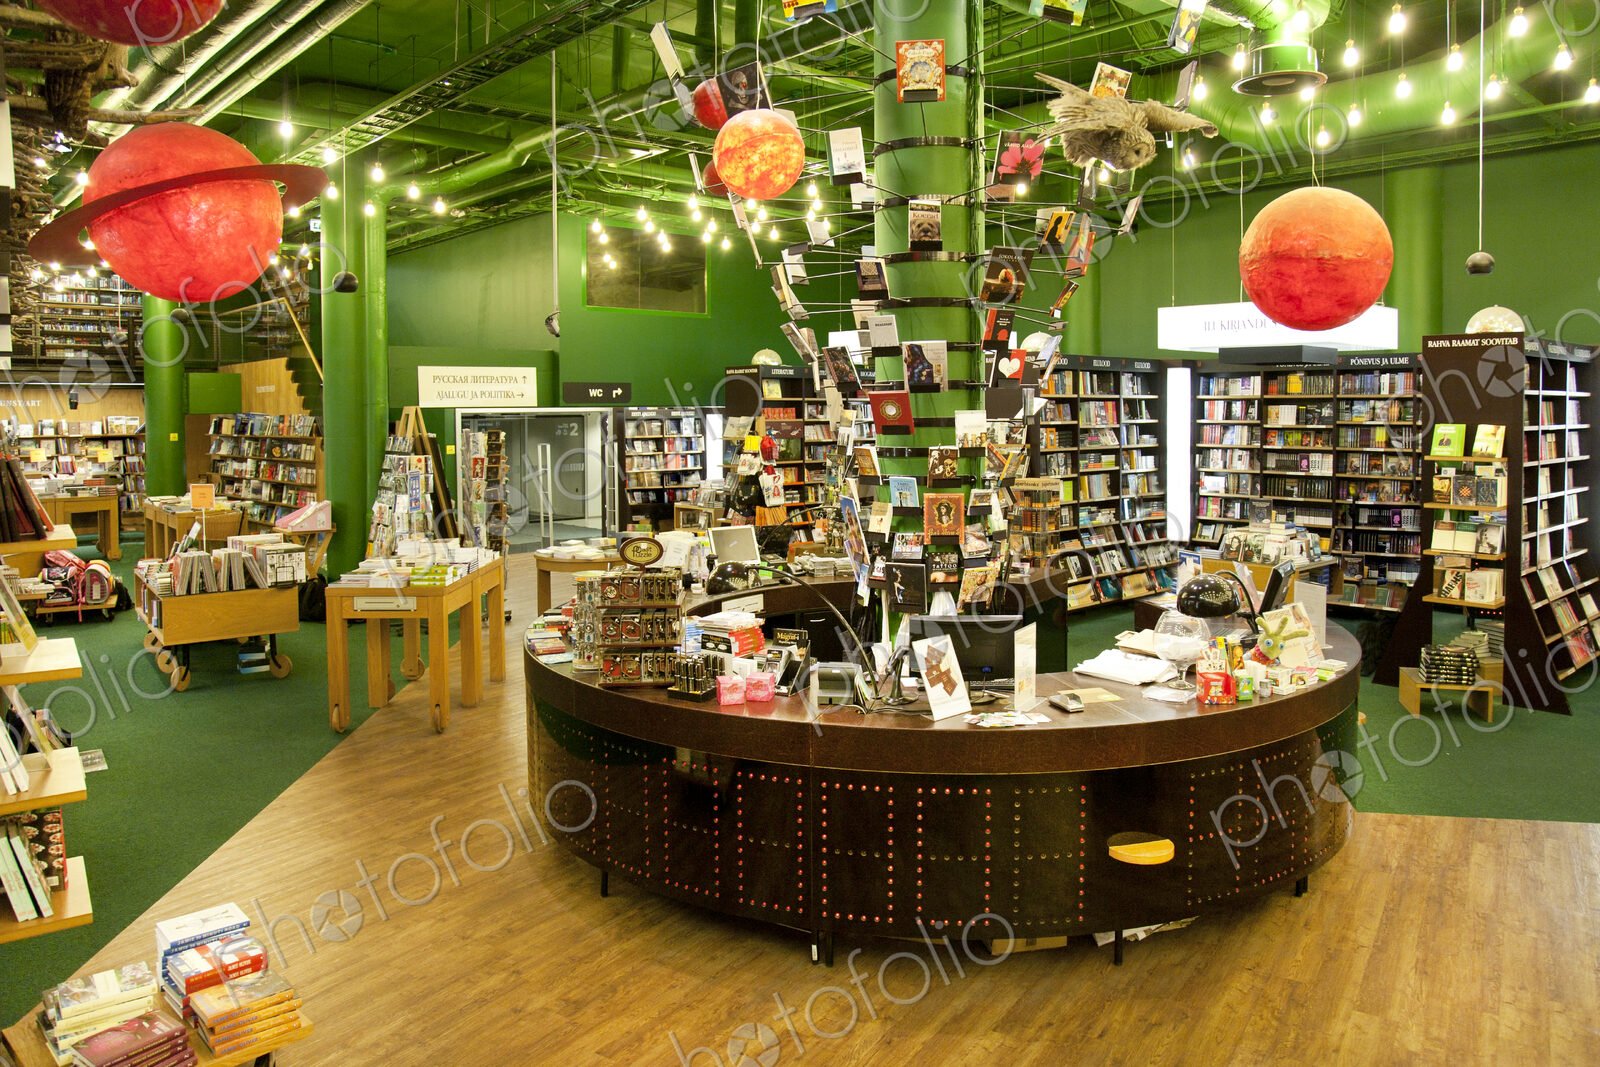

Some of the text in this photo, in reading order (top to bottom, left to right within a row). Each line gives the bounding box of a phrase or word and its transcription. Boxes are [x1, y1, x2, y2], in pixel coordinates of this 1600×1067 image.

[1427, 340, 1450, 348] RAHVA
[1451, 338, 1480, 347] RAAMAT
[1481, 337, 1518, 346] SOOVITAB
[1350, 356, 1409, 367] PÕNEVUS JA ULME
[432, 375, 518, 384] РУССКАЯ ЛИТЕРАТУРА
[436, 390, 515, 400] AJALUGU JA POLIITIKA
[588, 388, 603, 397] WC
[569, 422, 579, 436] 2
[1441, 571, 1463, 598] HARMS
[231, 1007, 251, 1020] OLIVER
[238, 1015, 259, 1028] OLIVER
[233, 1027, 254, 1040] OLIVER
[238, 1036, 259, 1050] OLIVER
